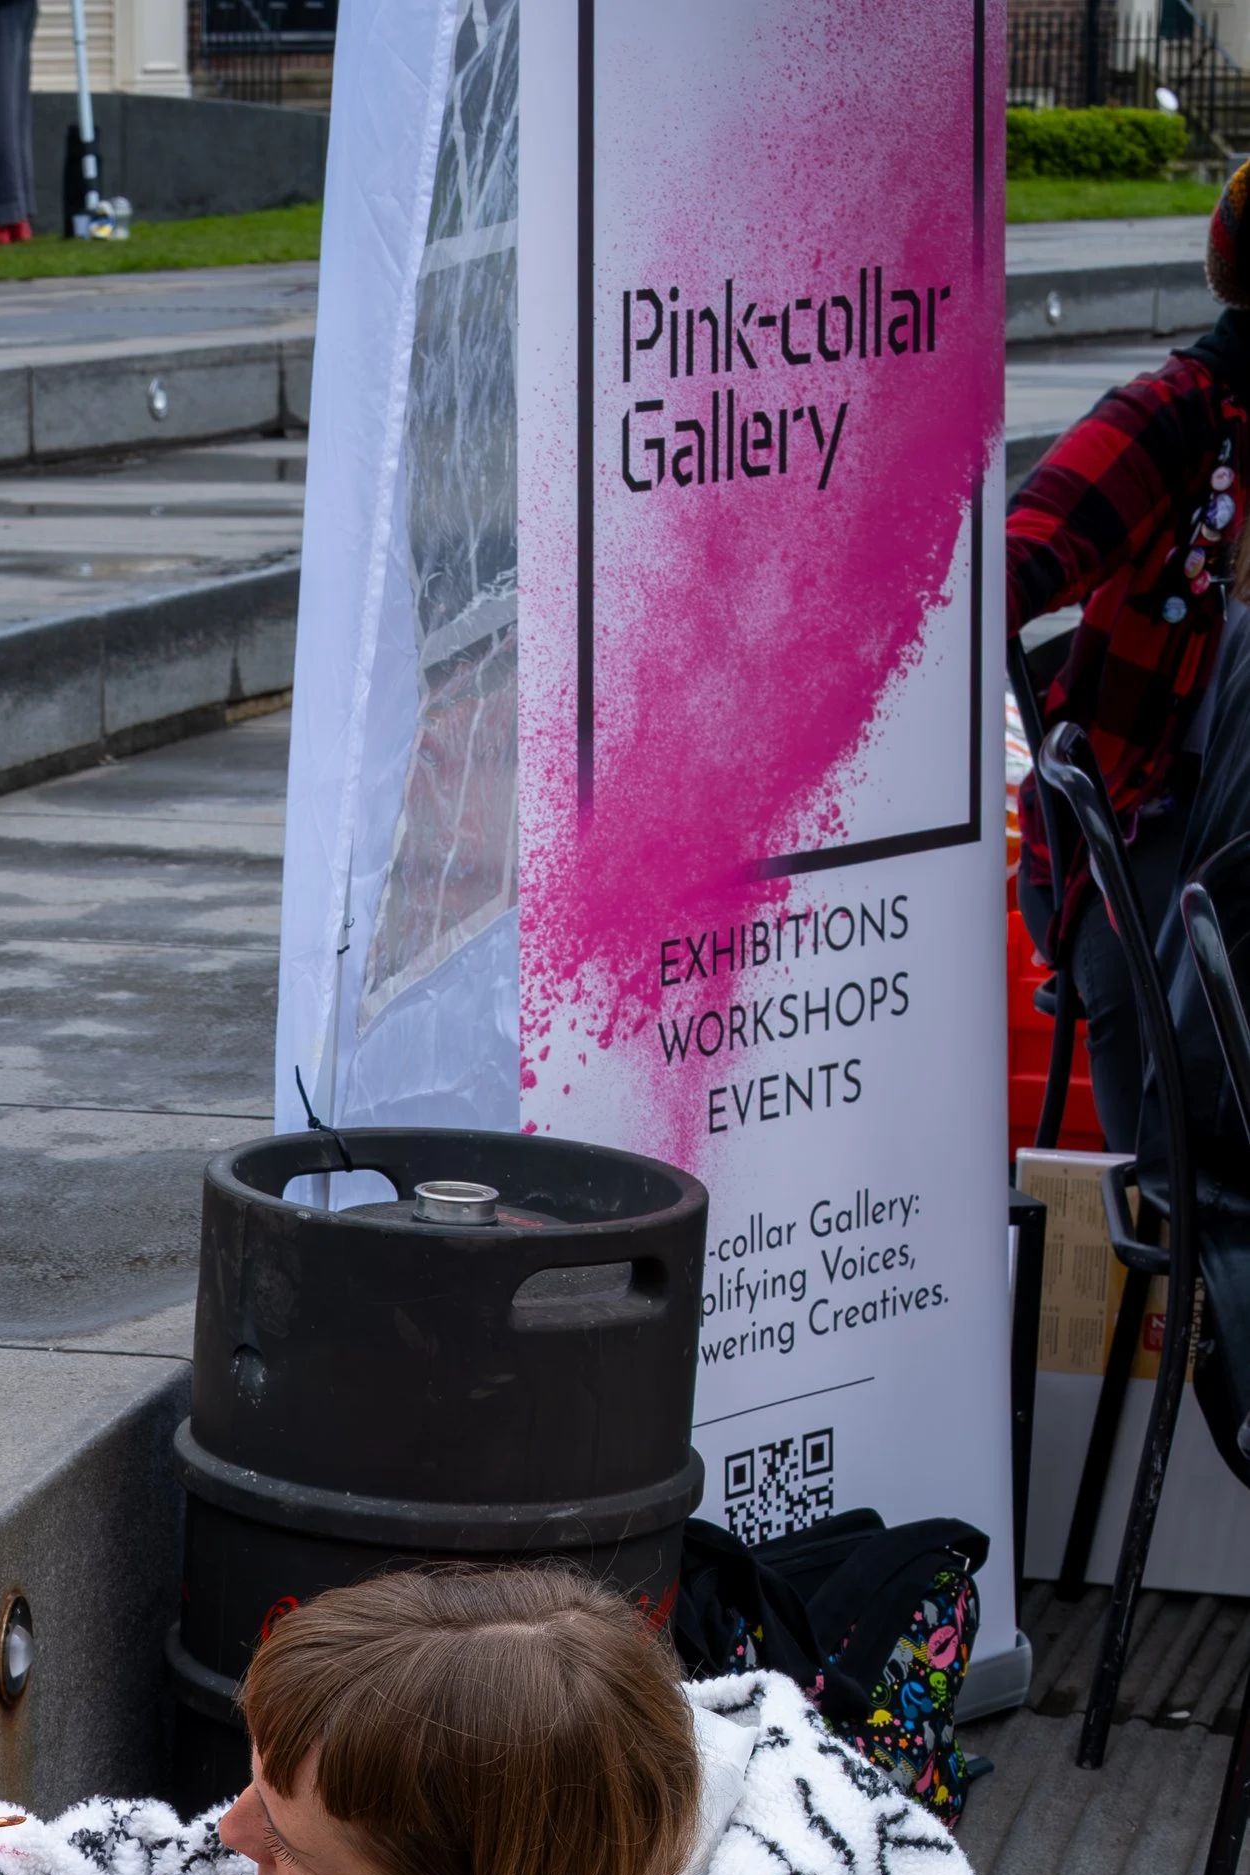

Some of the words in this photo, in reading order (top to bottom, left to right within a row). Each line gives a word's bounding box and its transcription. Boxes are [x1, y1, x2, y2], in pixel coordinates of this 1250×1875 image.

[622, 266, 950, 383] Pink-collar
[621, 388, 848, 493] Gallery
[659, 894, 909, 987] EXHIBITIONS
[658, 971, 910, 1066] WORKSHOPS
[707, 1058, 862, 1135] EVENTS
[707, 1211, 796, 1263] -collar
[810, 1187, 920, 1238] Gallery:
[700, 1267, 807, 1328] plifying
[821, 1243, 916, 1285] Voices,
[700, 1320, 795, 1367] wering
[808, 1282, 949, 1336] Creatives.
